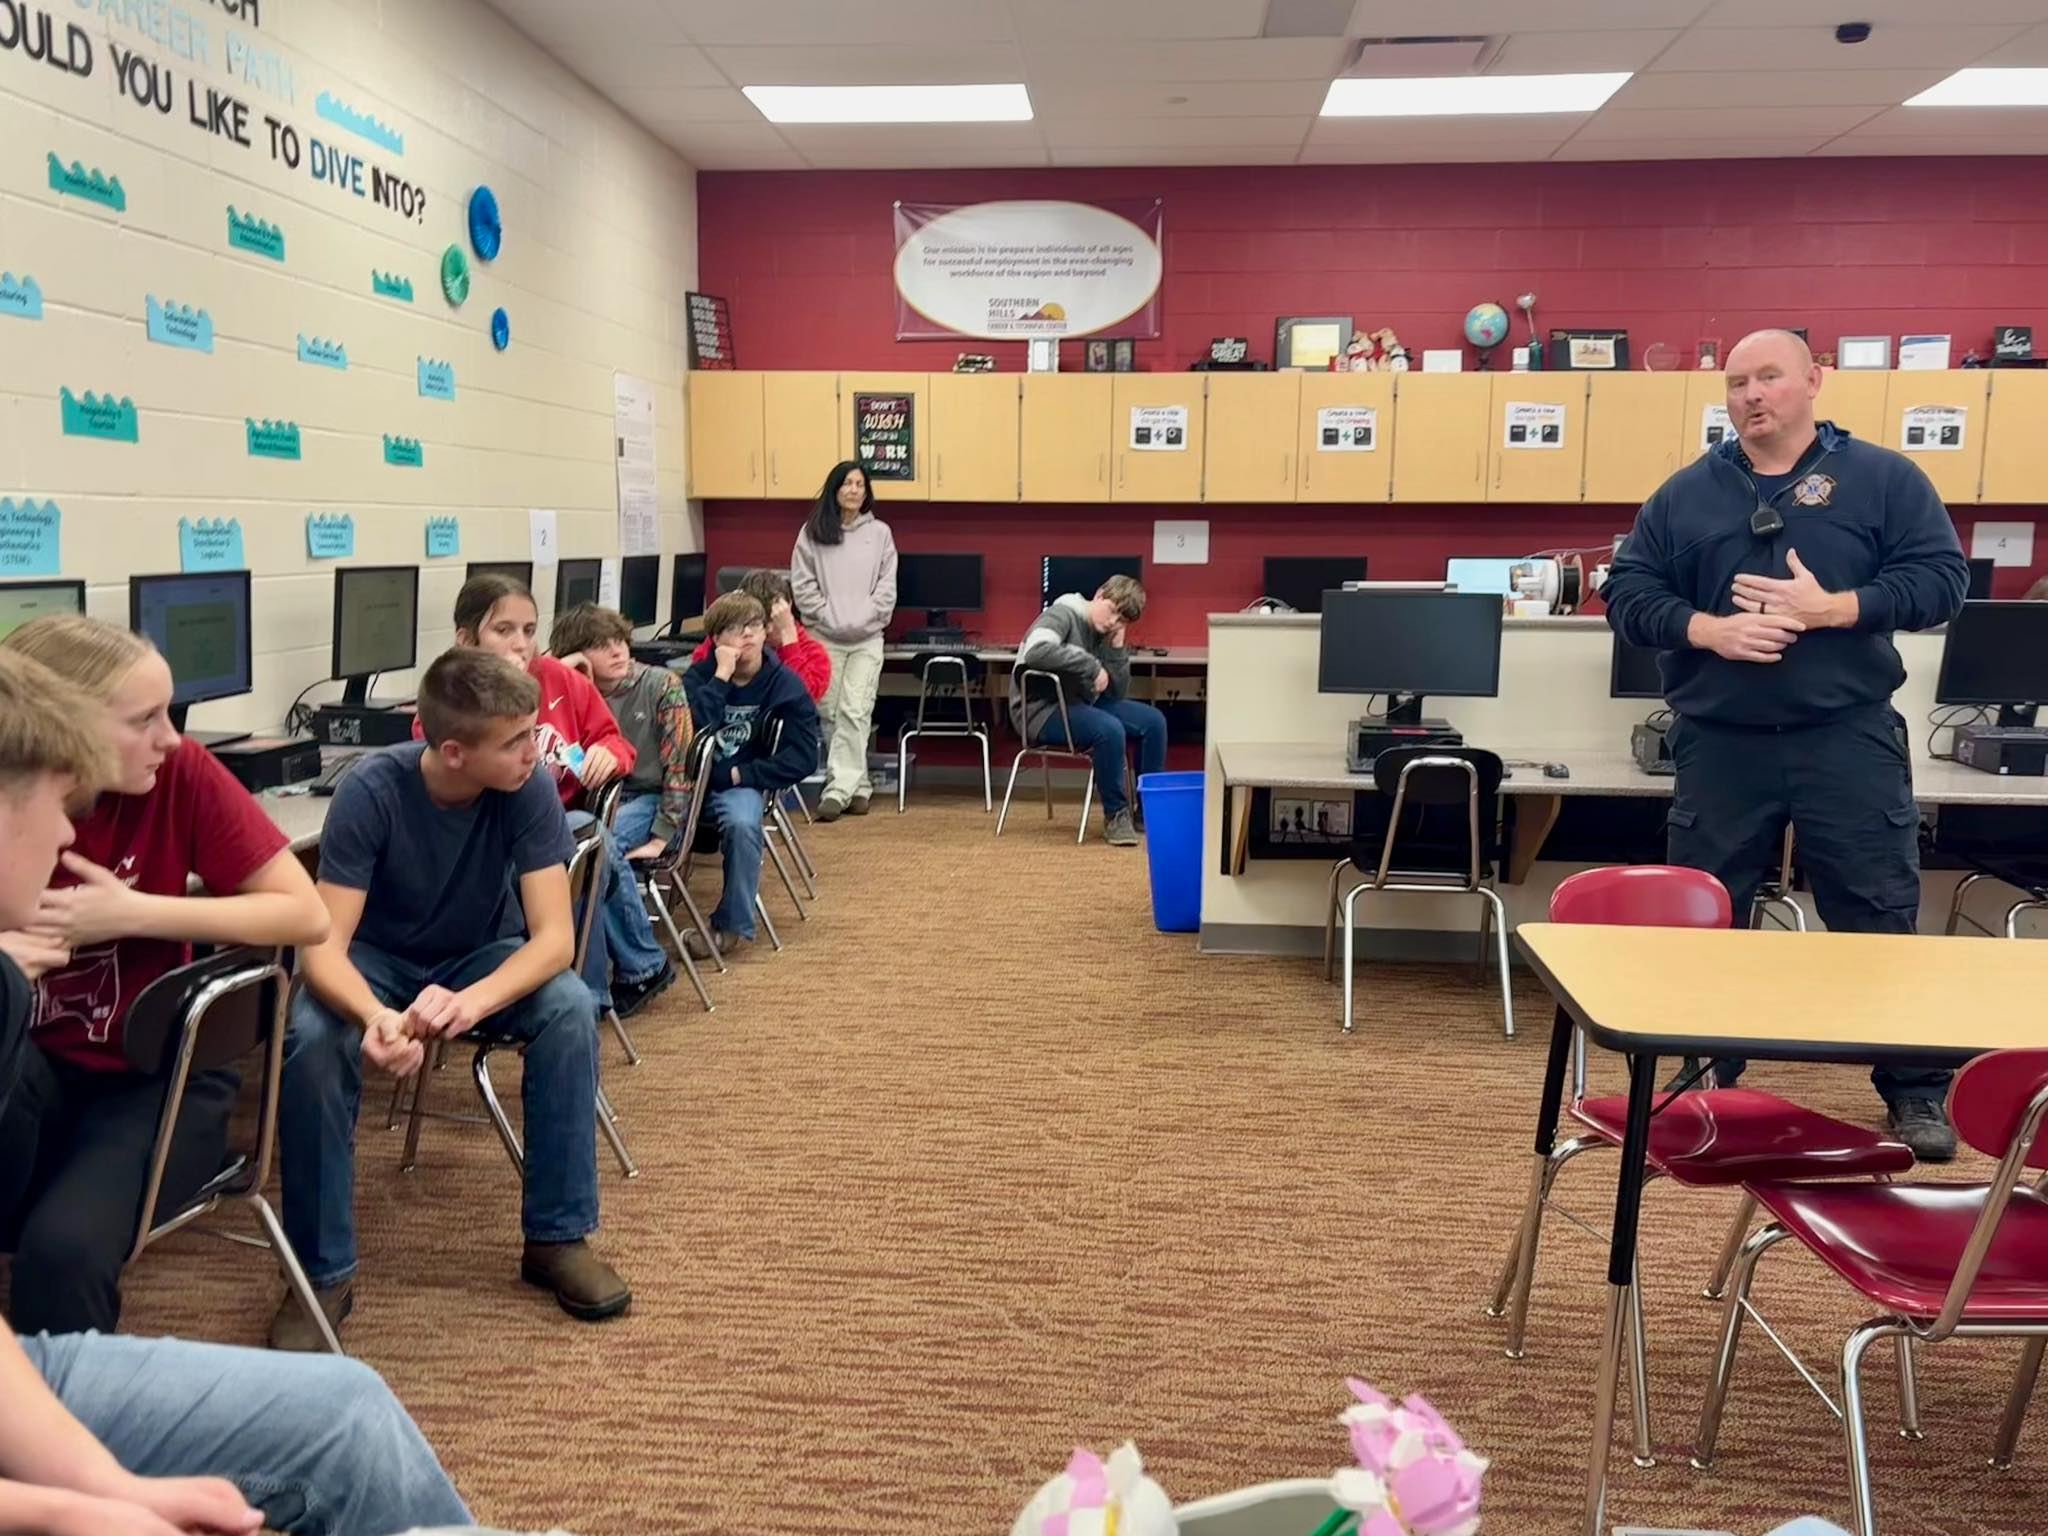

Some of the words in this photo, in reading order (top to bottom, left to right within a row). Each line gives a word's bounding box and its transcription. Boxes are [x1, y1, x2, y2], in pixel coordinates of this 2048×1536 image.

[225, 30, 295, 104] PATH
[109, 43, 172, 114] YOU
[188, 79, 250, 148] LIKE
[264, 114, 300, 169] TO
[310, 137, 365, 197] DIVE
[371, 165, 426, 225] INTO?
[988, 297, 1040, 308] SOUTHERN
[988, 309, 1016, 319] HILLS
[863, 413, 905, 430] WISH
[860, 444, 907, 460] WORK
[1176, 535, 1185, 548] 3
[1997, 537, 2007, 549] 4
